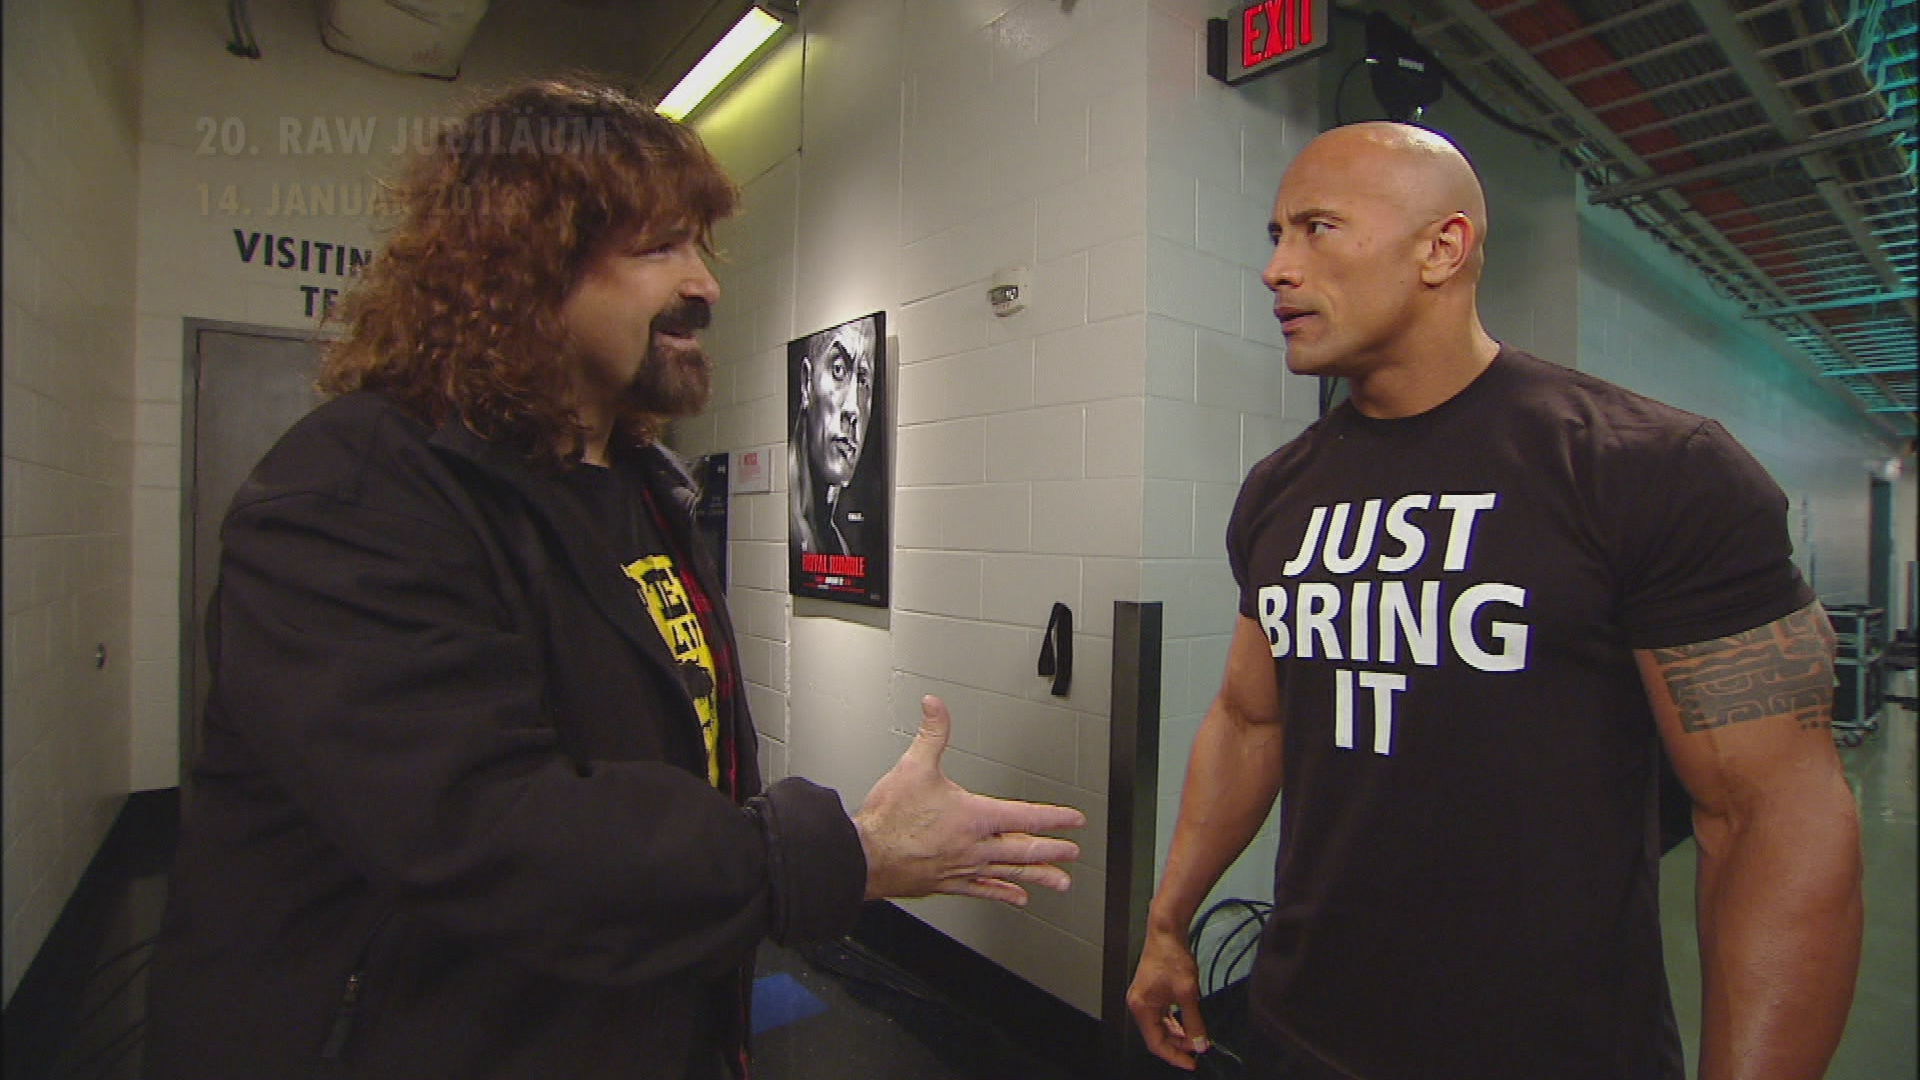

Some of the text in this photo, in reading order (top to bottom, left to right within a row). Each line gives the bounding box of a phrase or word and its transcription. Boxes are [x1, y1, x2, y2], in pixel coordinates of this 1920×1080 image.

[233, 229, 372, 276] VISITIN
[1282, 492, 1497, 576] JUST
[1258, 580, 1529, 672] BRING
[1335, 668, 1407, 756] IT
